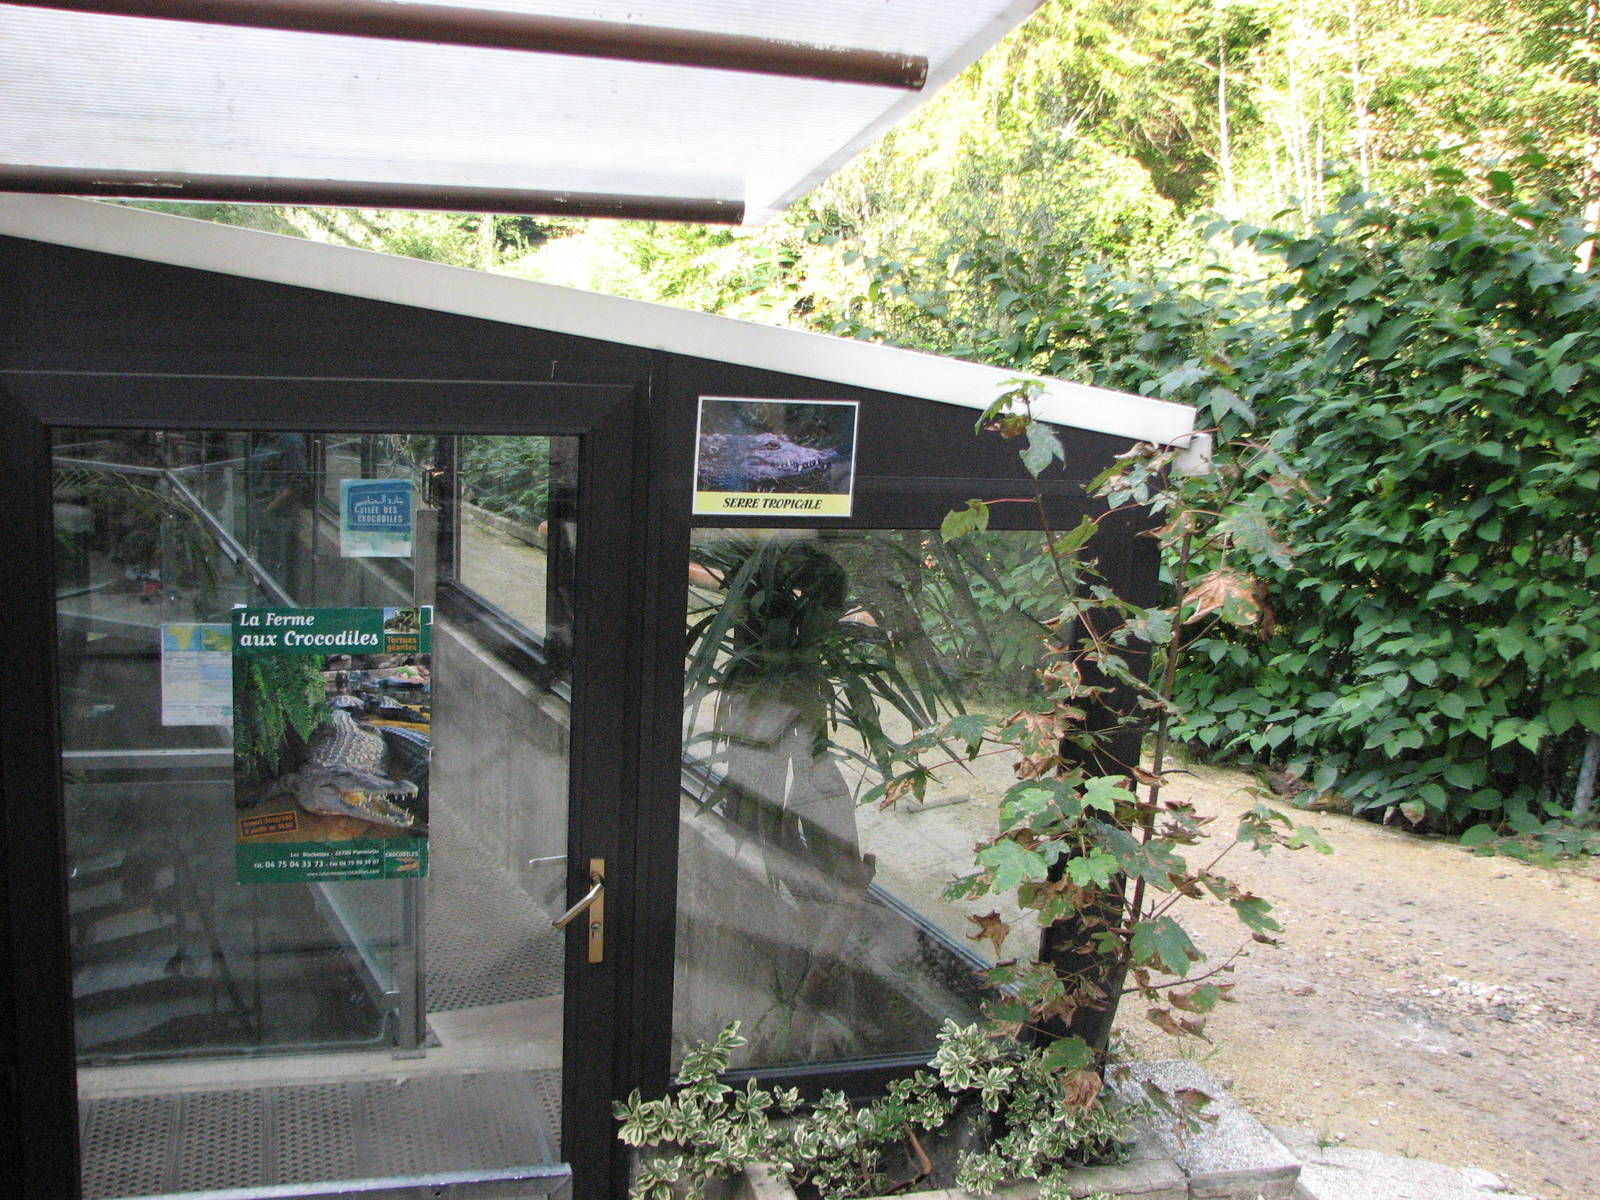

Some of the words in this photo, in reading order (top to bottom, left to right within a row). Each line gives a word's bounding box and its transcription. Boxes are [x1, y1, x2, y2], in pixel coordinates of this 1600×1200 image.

[383, 506, 398, 514] DES
[722, 497, 758, 509] SERRE
[762, 498, 823, 510] TROPICALE
[240, 613, 260, 627] La
[265, 613, 315, 627] Ferme
[240, 634, 277, 647] aux
[283, 631, 379, 647] Crocodiles
[265, 861, 275, 869] 04
[278, 861, 287, 869] 75
[289, 860, 300, 868] 04
[301, 860, 312, 868] 33
[314, 860, 324, 868] 73
